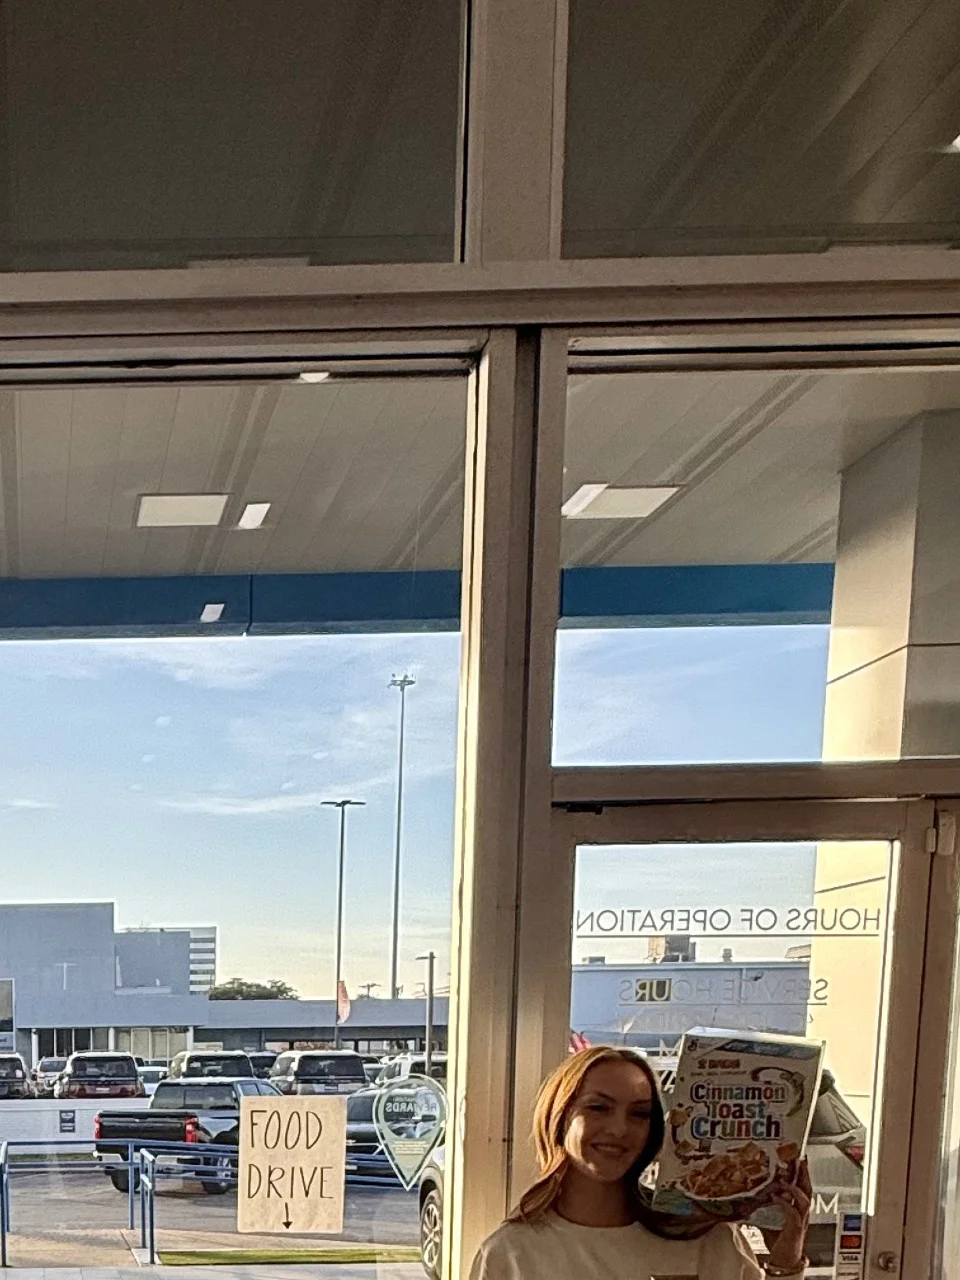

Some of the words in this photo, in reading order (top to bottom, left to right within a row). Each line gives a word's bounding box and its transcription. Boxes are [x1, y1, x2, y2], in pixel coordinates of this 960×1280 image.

[693, 1080, 786, 1100] Cinnamon
[708, 1100, 767, 1119] Toast
[250, 1109, 323, 1150] FOOD
[693, 1115, 781, 1138] Crunch
[247, 1163, 334, 1199] DRIVE
